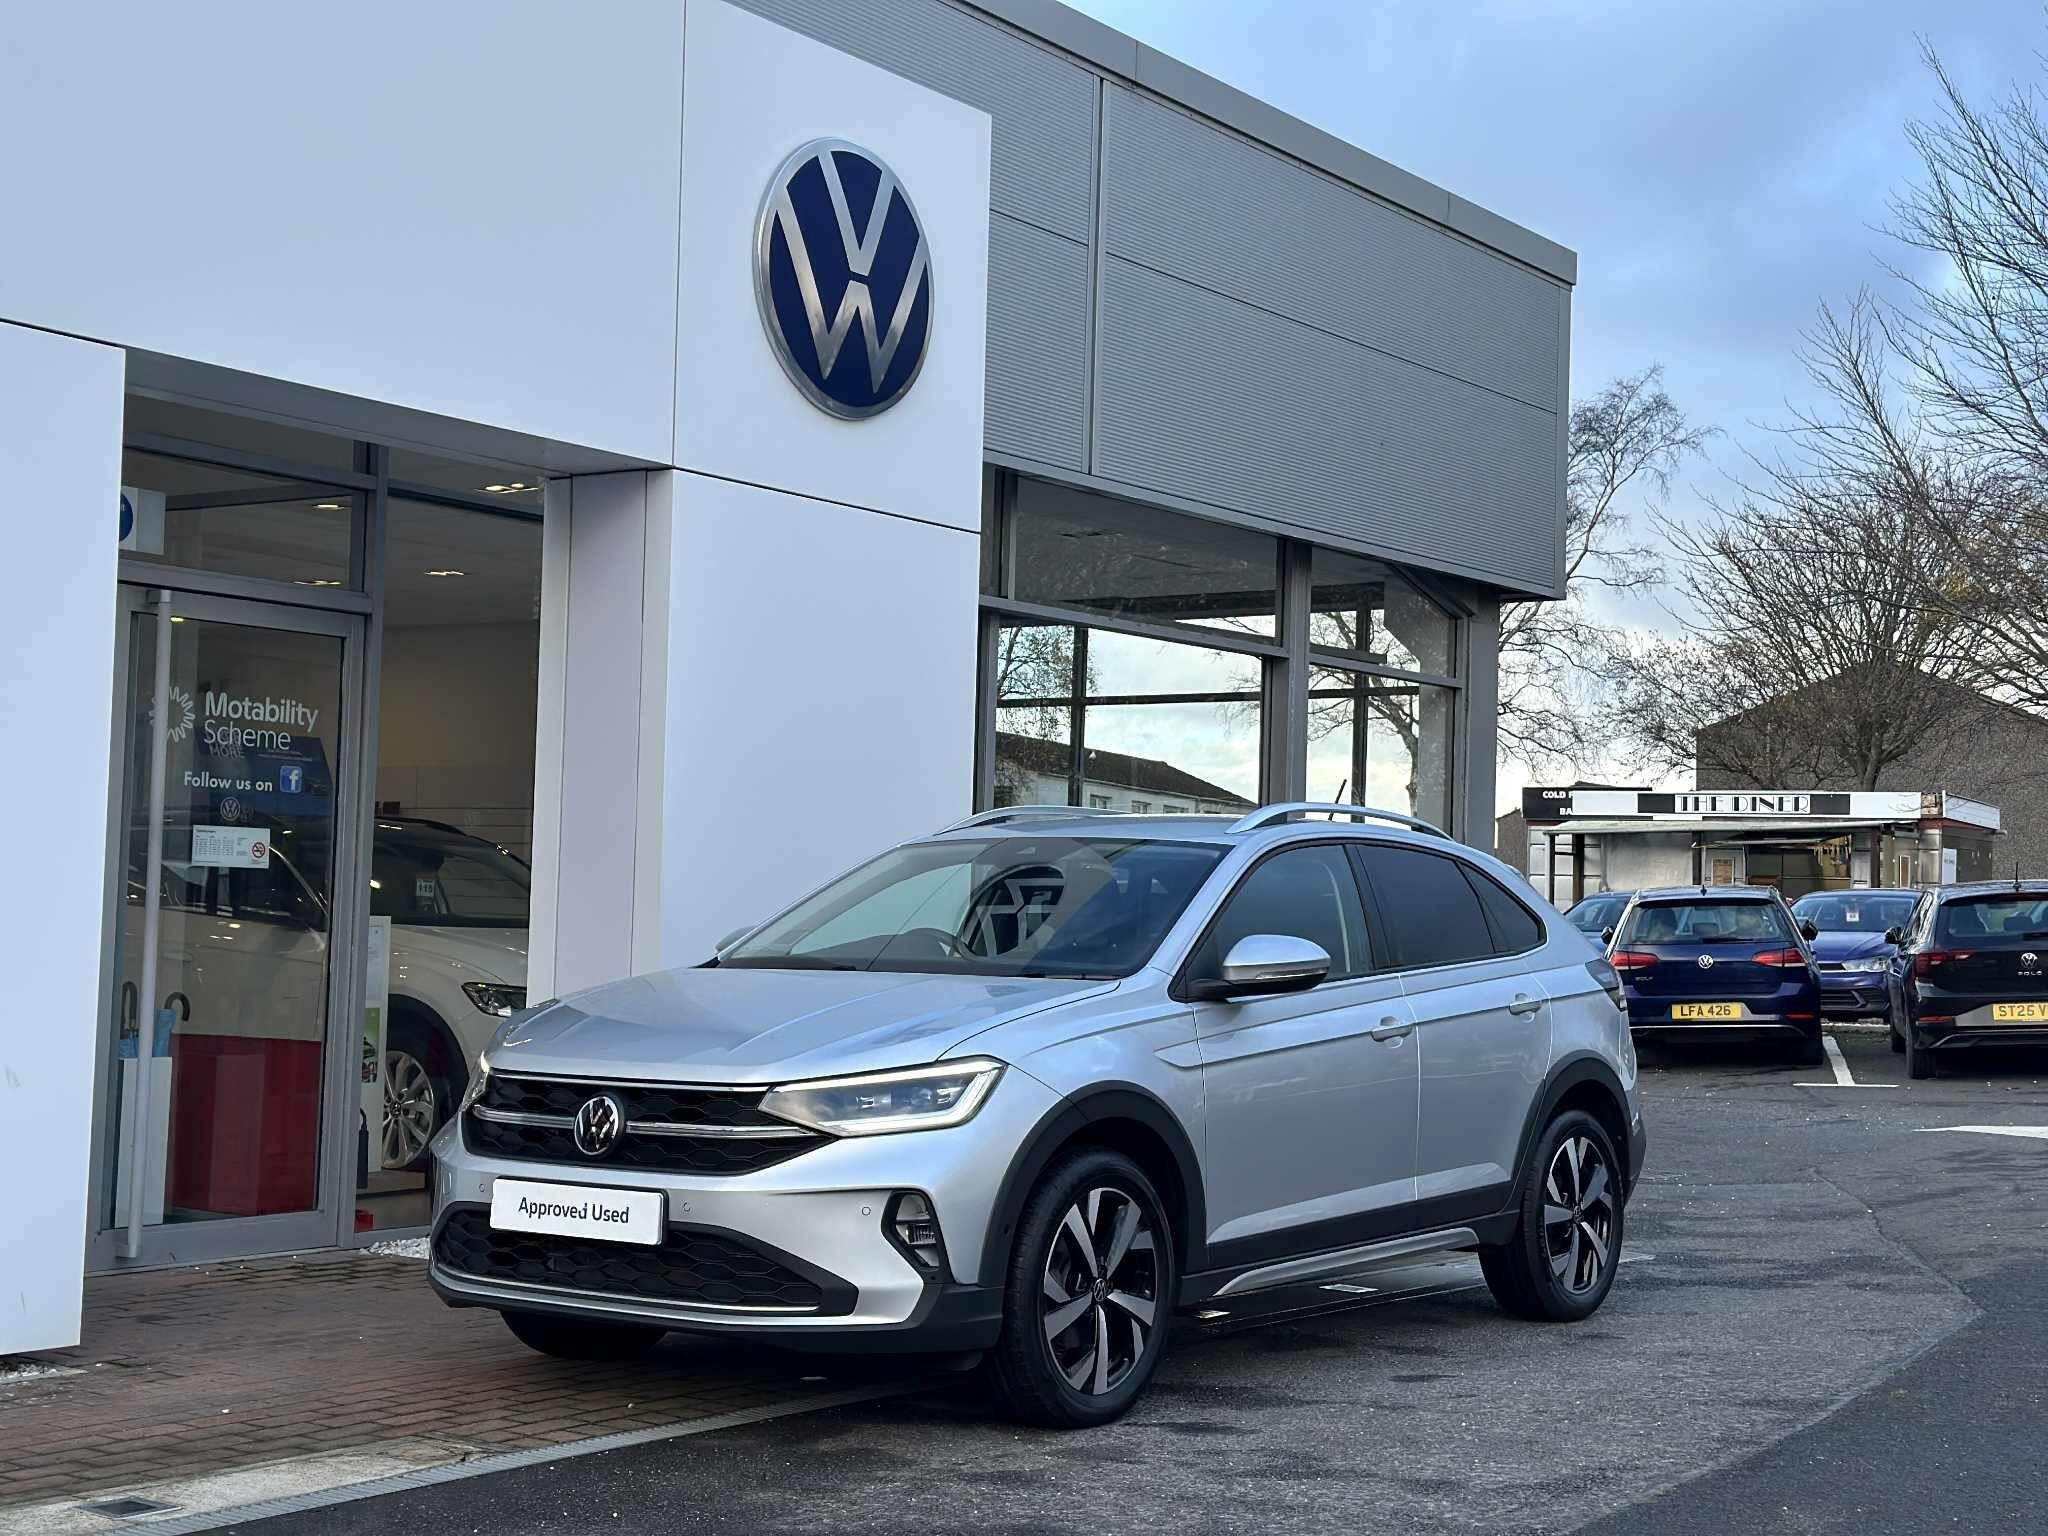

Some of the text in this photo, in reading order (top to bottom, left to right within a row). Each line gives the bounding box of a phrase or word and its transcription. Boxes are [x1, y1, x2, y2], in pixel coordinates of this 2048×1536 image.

[205, 691, 319, 733] Motability
[203, 719, 292, 750] Scheme
[184, 771, 232, 789] Follow
[236, 779, 252, 790] us
[255, 781, 273, 792] on
[1542, 790, 1566, 799] COLD
[1677, 795, 1809, 813] THE DINER
[1680, 1005, 1732, 1017] LFA 426
[518, 1196, 630, 1224] Approved Used
